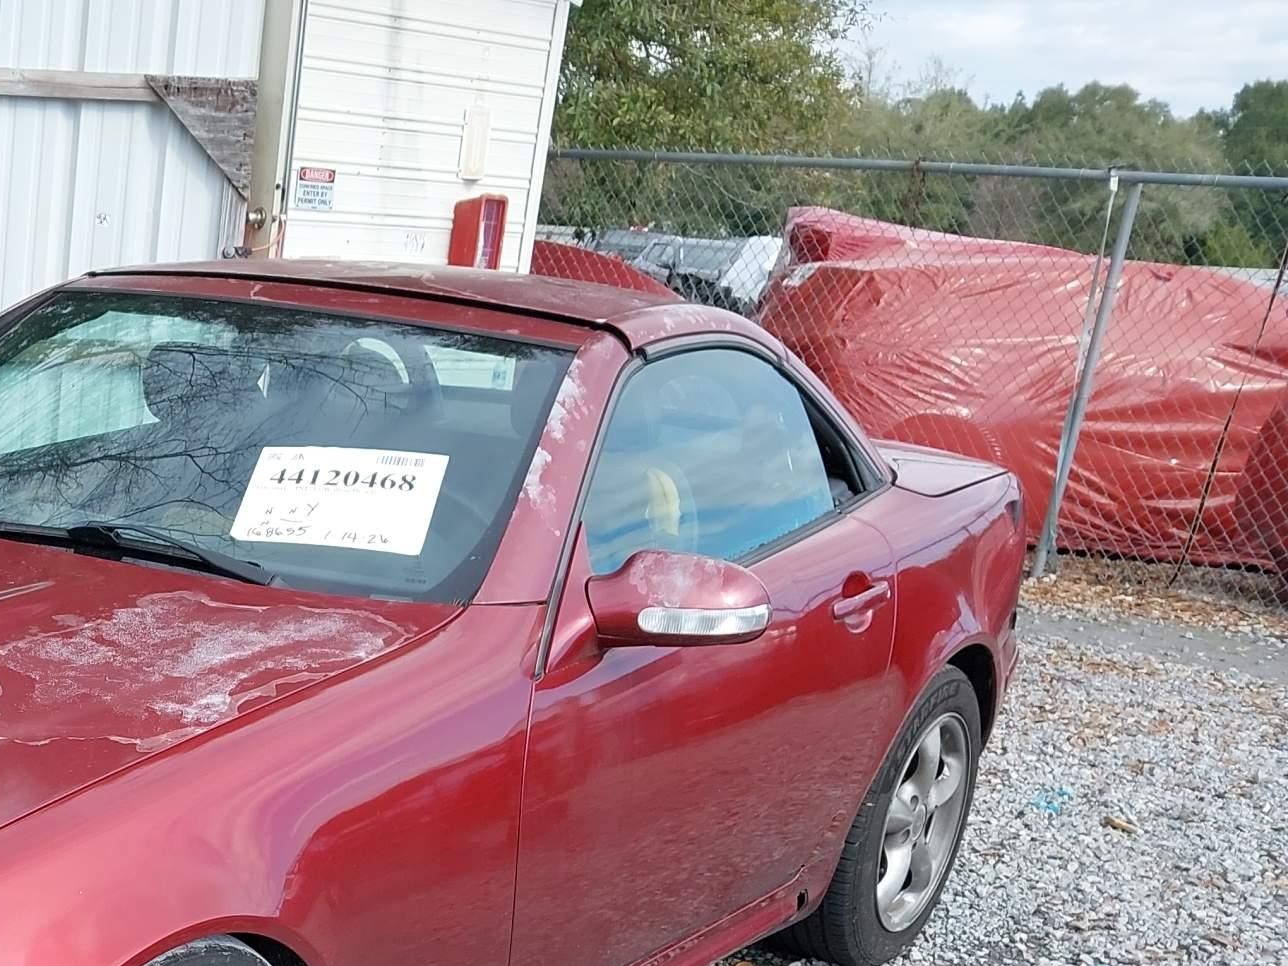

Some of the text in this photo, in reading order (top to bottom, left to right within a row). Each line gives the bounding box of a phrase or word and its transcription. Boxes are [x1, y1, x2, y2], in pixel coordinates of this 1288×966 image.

[306, 169, 328, 180] DANGER
[303, 189, 320, 197] ENTER
[317, 198, 331, 206] ONLY
[269, 467, 417, 492] 44120468
